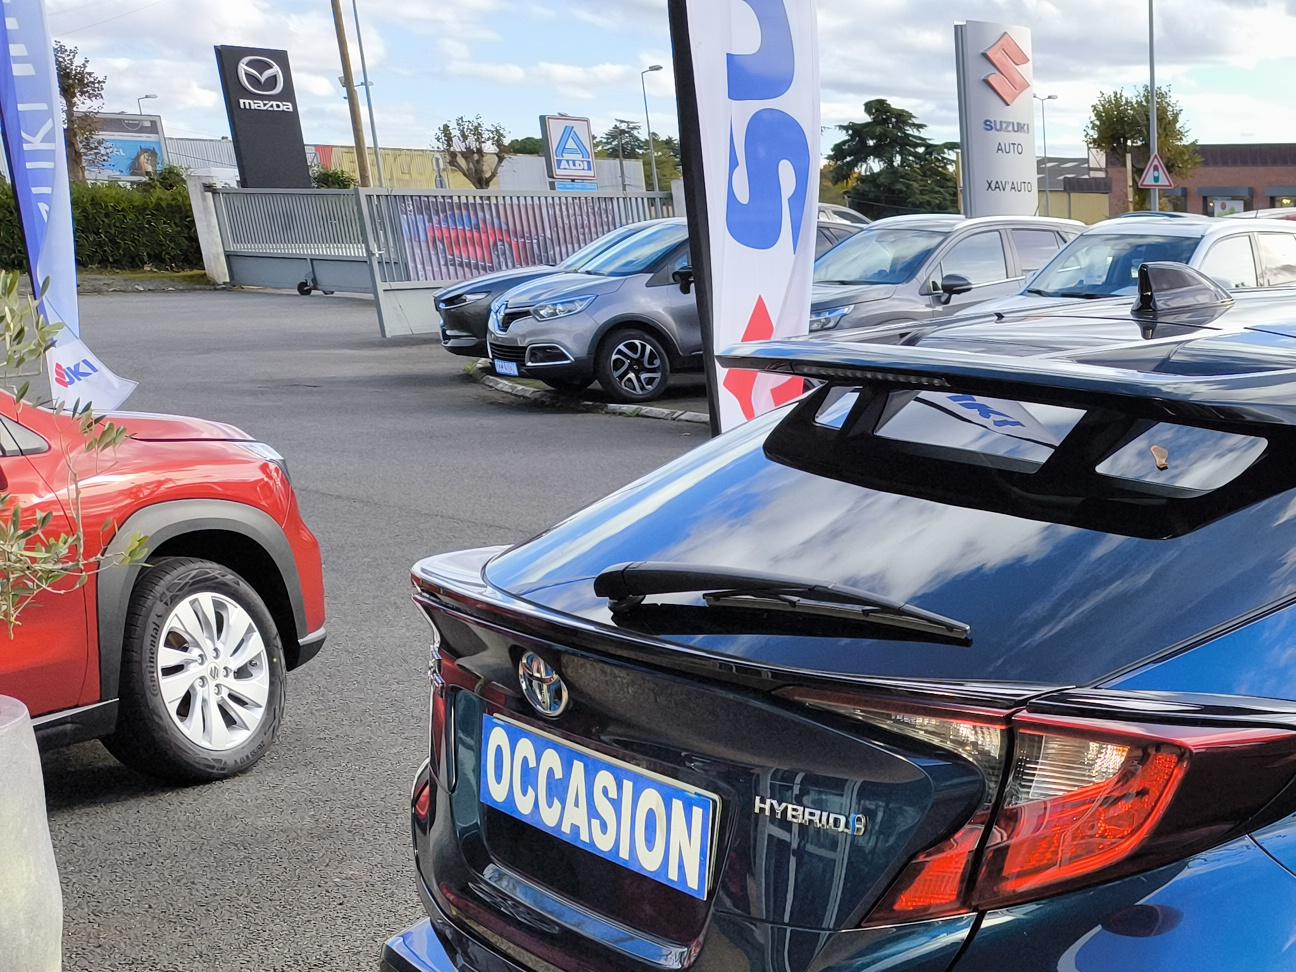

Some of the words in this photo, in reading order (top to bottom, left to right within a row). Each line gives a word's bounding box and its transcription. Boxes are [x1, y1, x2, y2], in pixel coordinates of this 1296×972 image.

[239, 98, 293, 112] mazda
[983, 119, 1030, 134] SUZUKI
[996, 142, 1024, 155] AUTO
[560, 159, 588, 170] ALDI
[986, 179, 1033, 193] XAV'AUTO
[486, 726, 703, 890] OCCASION
[754, 795, 848, 833] HYBRID
